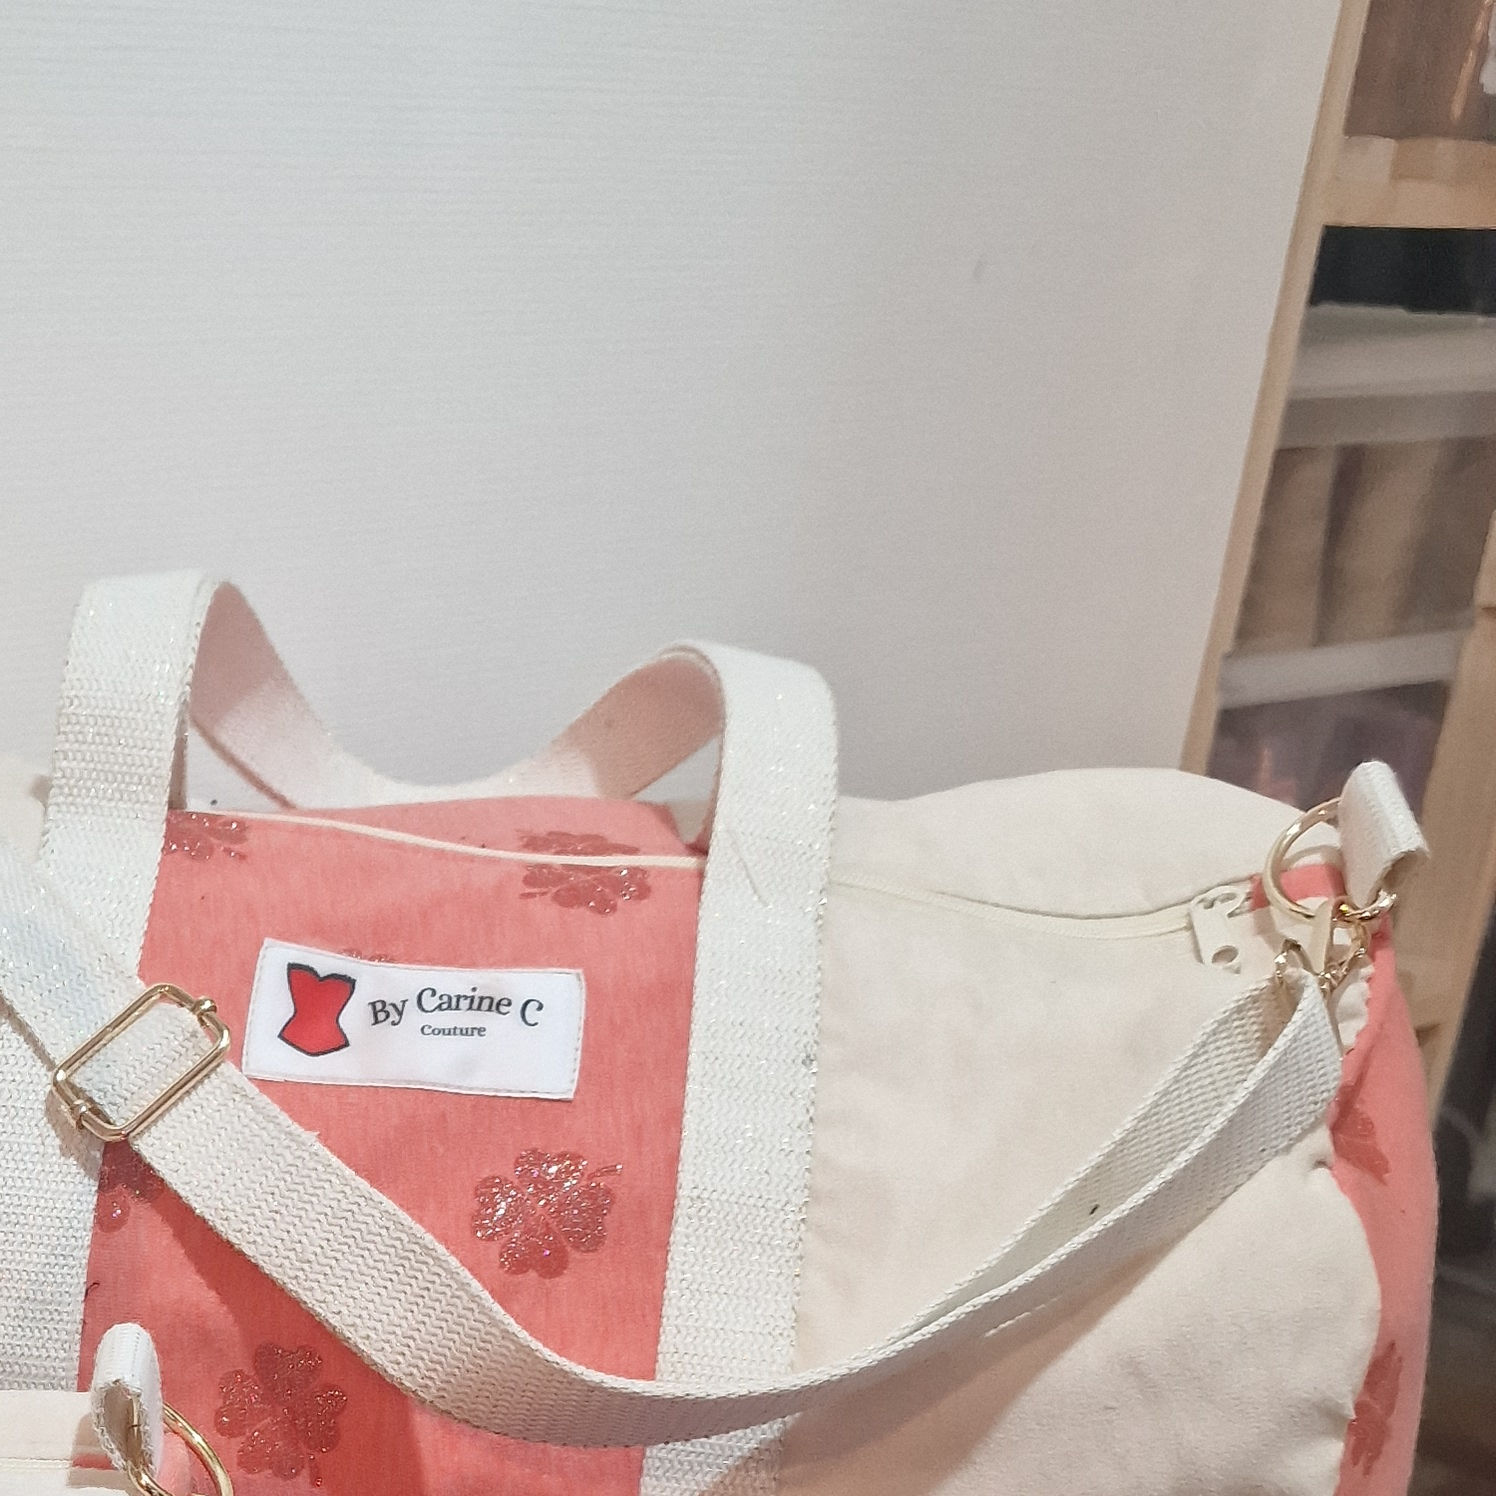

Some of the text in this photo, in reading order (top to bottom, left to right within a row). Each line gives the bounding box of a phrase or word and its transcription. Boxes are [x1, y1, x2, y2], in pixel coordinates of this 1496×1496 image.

[368, 986, 544, 1027] By Carine C
[420, 1024, 487, 1037] Couture
